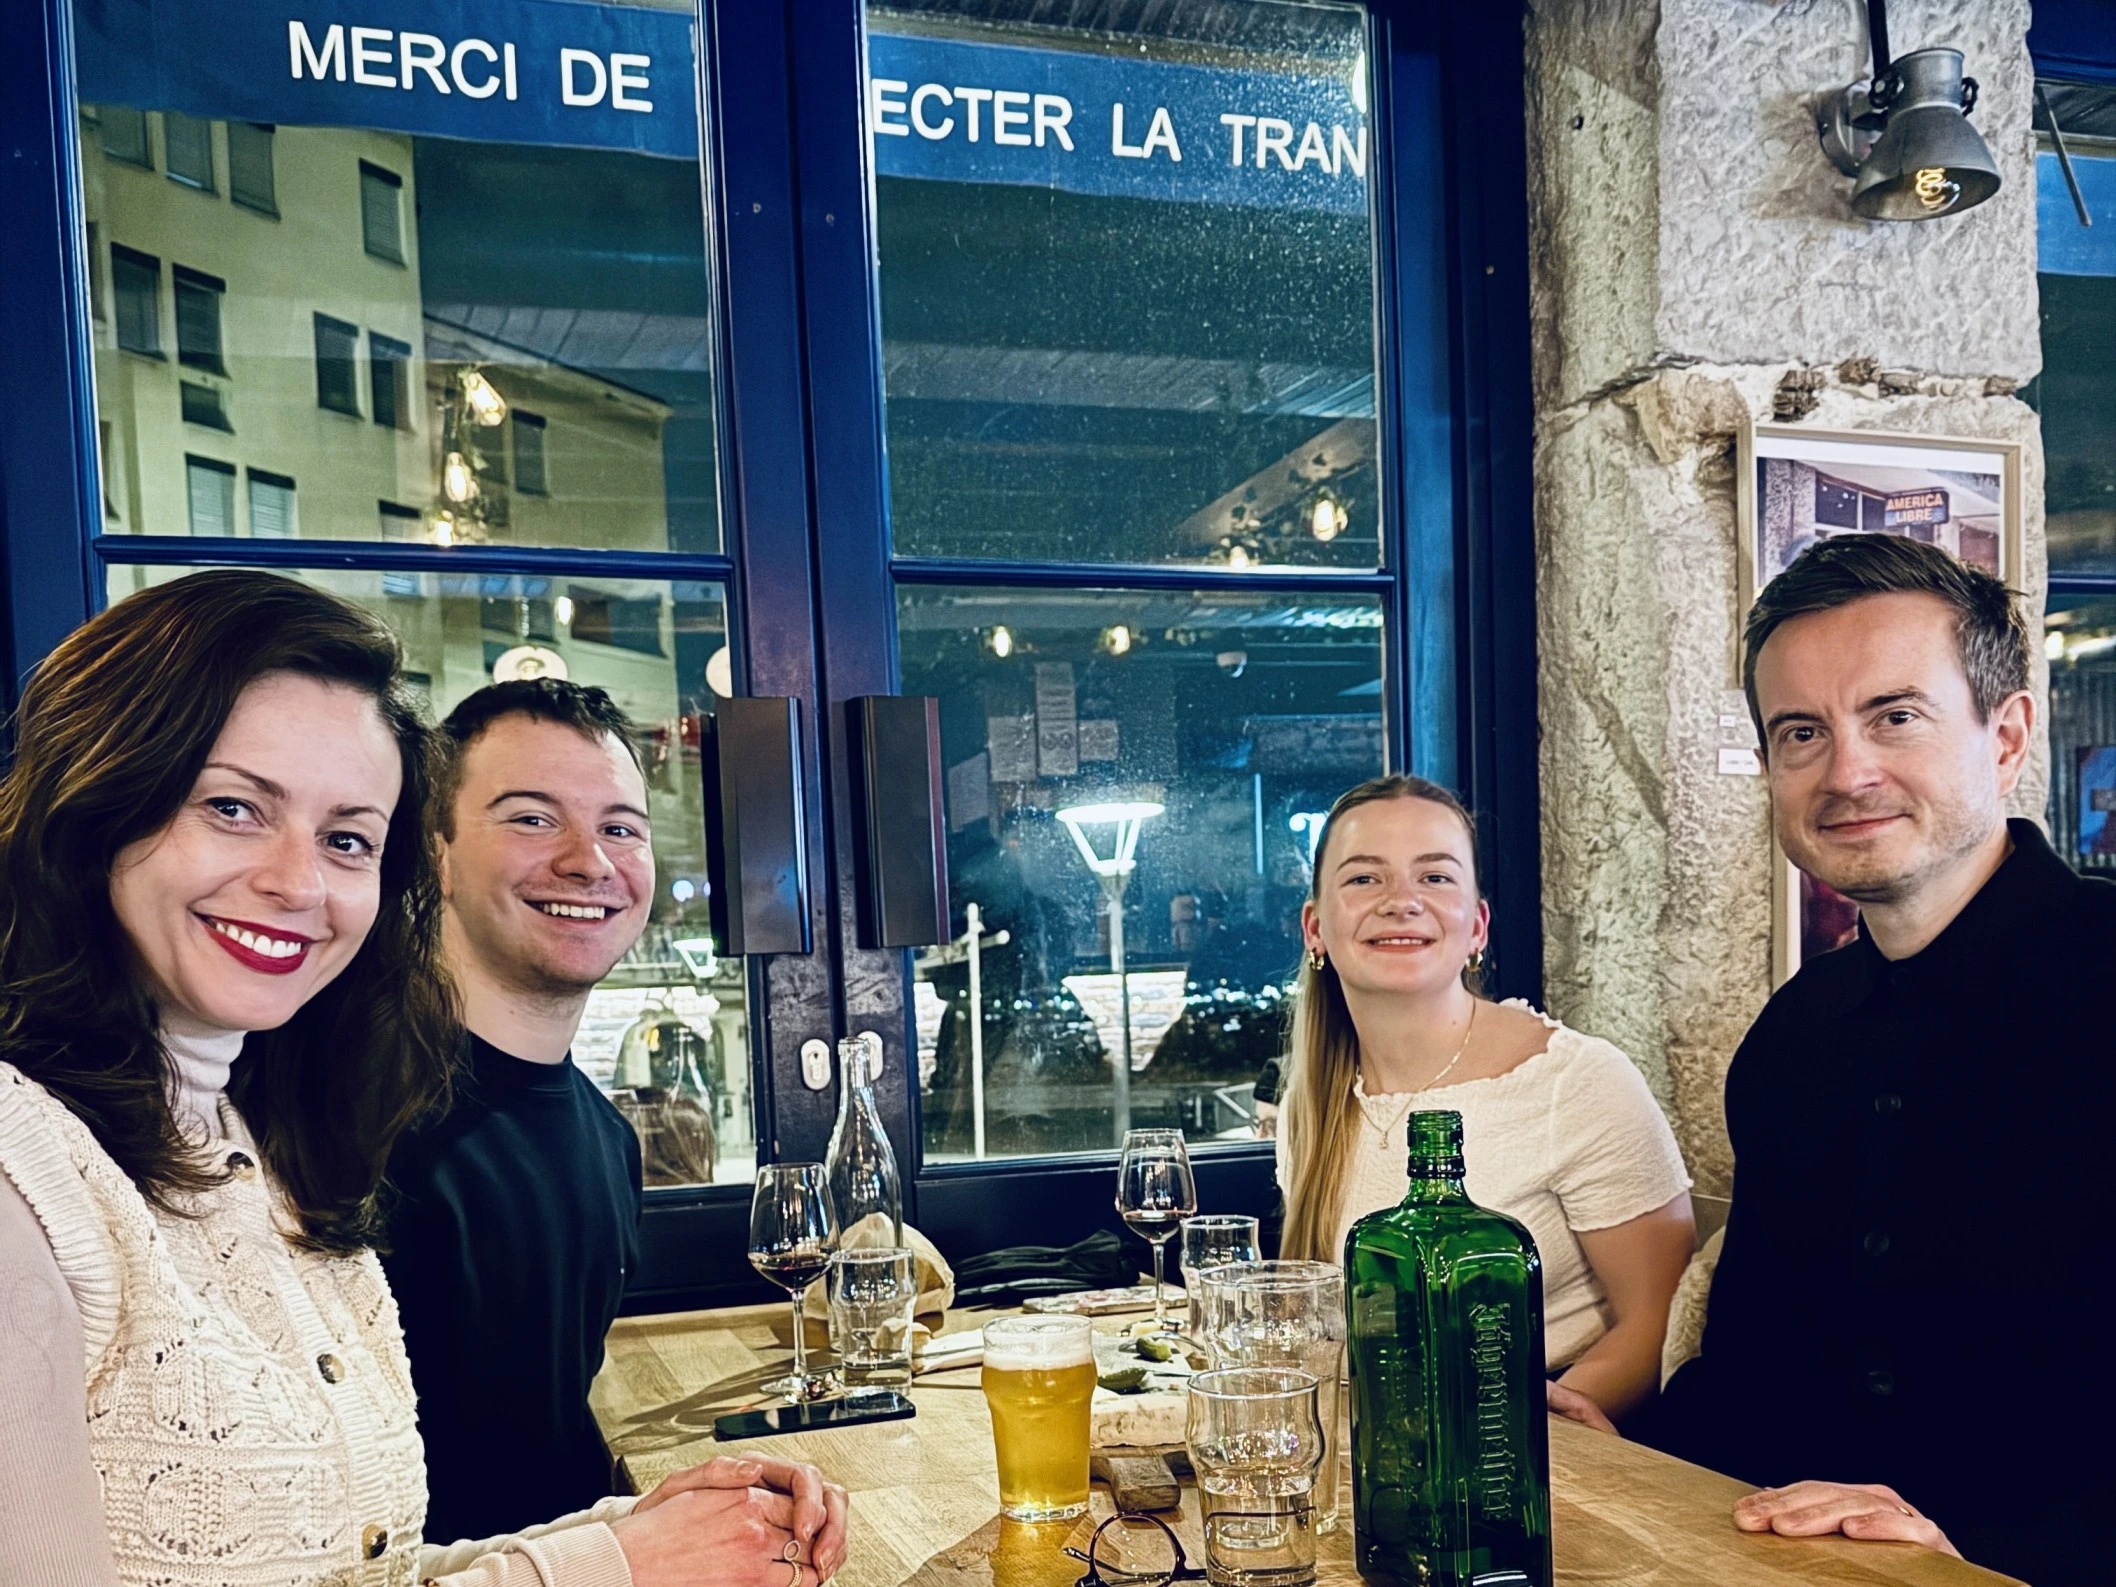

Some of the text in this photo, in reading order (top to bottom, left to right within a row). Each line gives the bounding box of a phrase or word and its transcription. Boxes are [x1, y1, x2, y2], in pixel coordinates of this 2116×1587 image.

[288, 20, 1368, 178] MERCI DE ECTER LA TRAN
[1886, 493, 1944, 511] AMERICA
[1895, 508, 1933, 524] LIBRE
